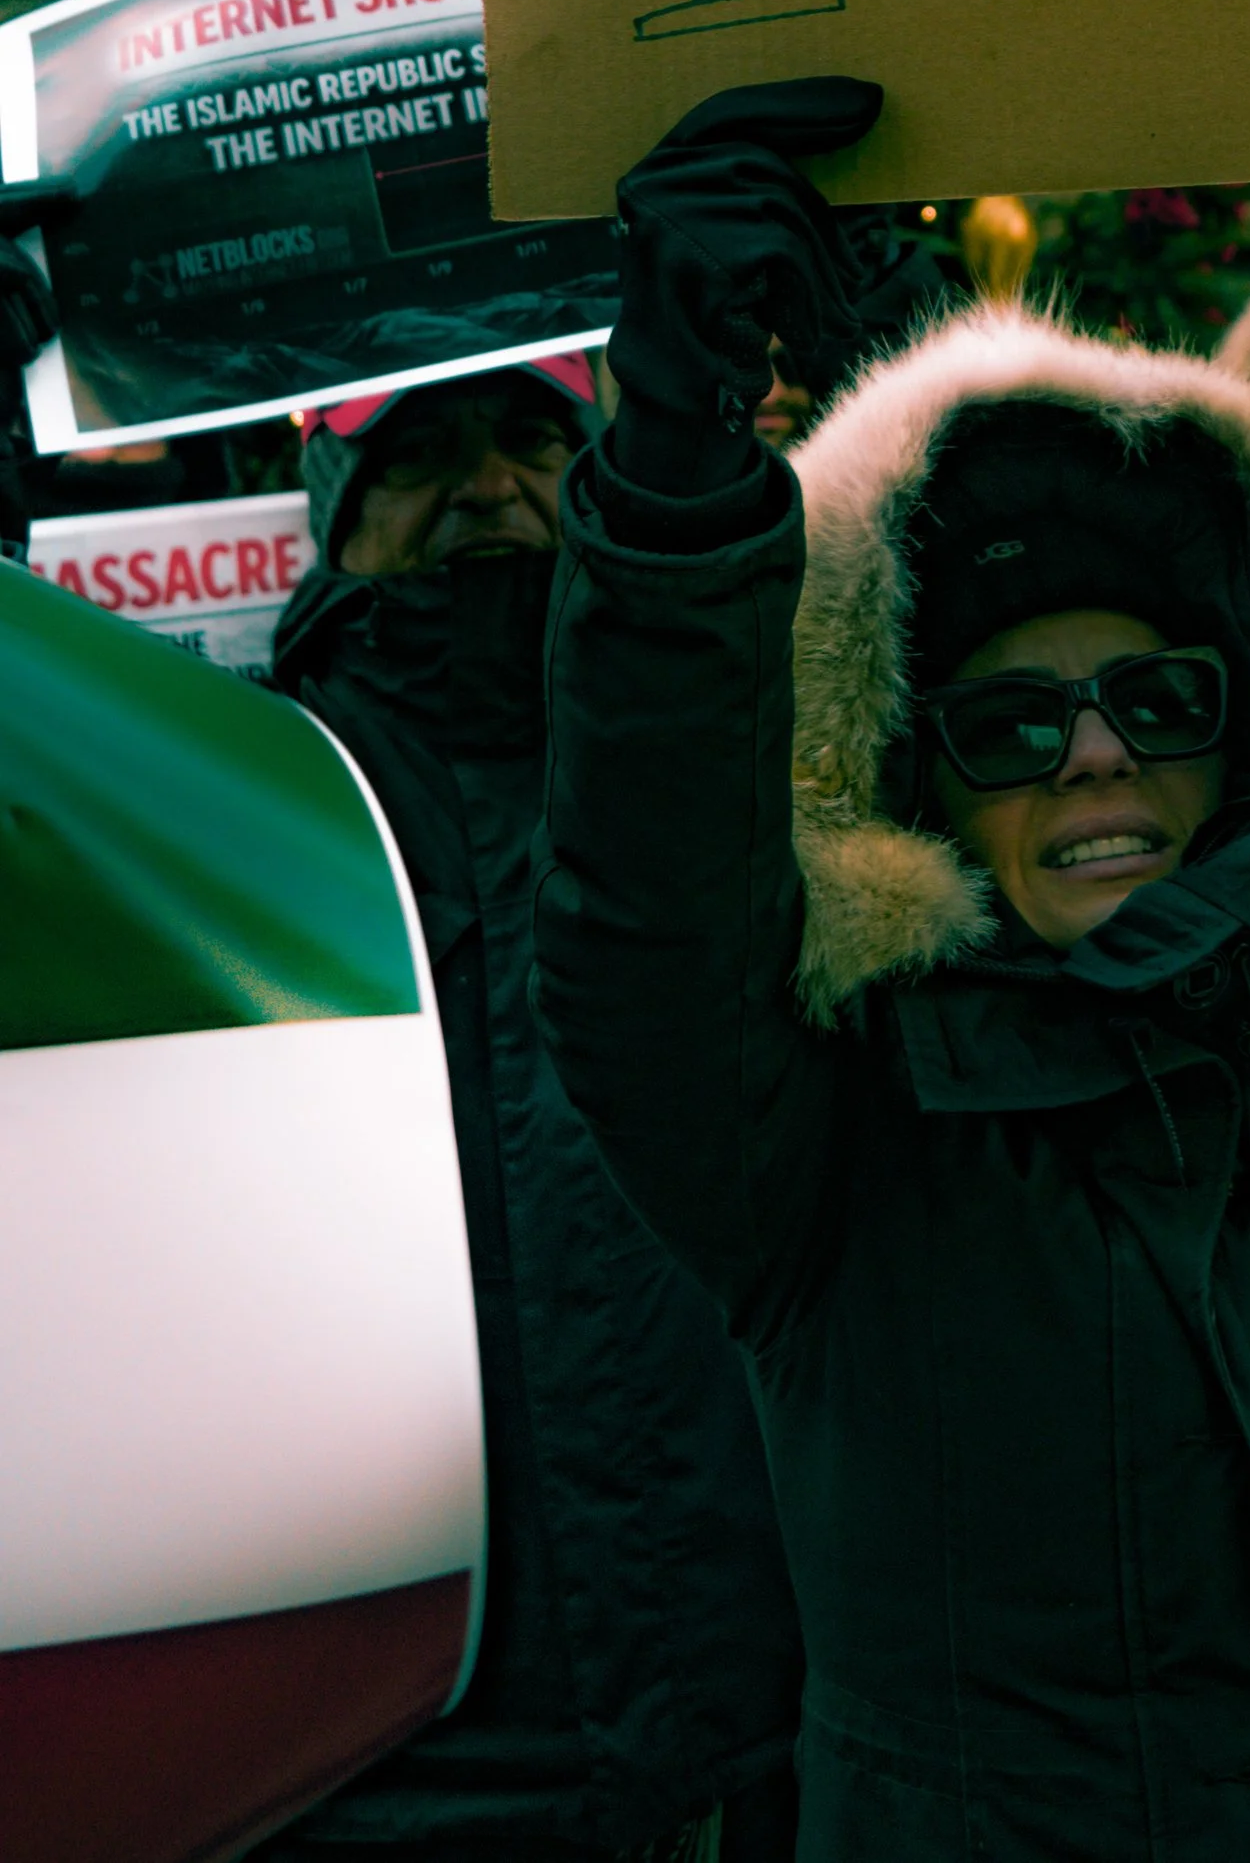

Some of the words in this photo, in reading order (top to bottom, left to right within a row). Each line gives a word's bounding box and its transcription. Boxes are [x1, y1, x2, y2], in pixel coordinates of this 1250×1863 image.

[123, 104, 181, 140] THE
[187, 77, 313, 130] ISLAMIC
[318, 50, 466, 102] REPUBLIC
[206, 131, 277, 172] THE
[282, 92, 453, 157] INTERNET
[175, 225, 316, 280] NETBLOCKS
[29, 534, 300, 610] ASSACRE
